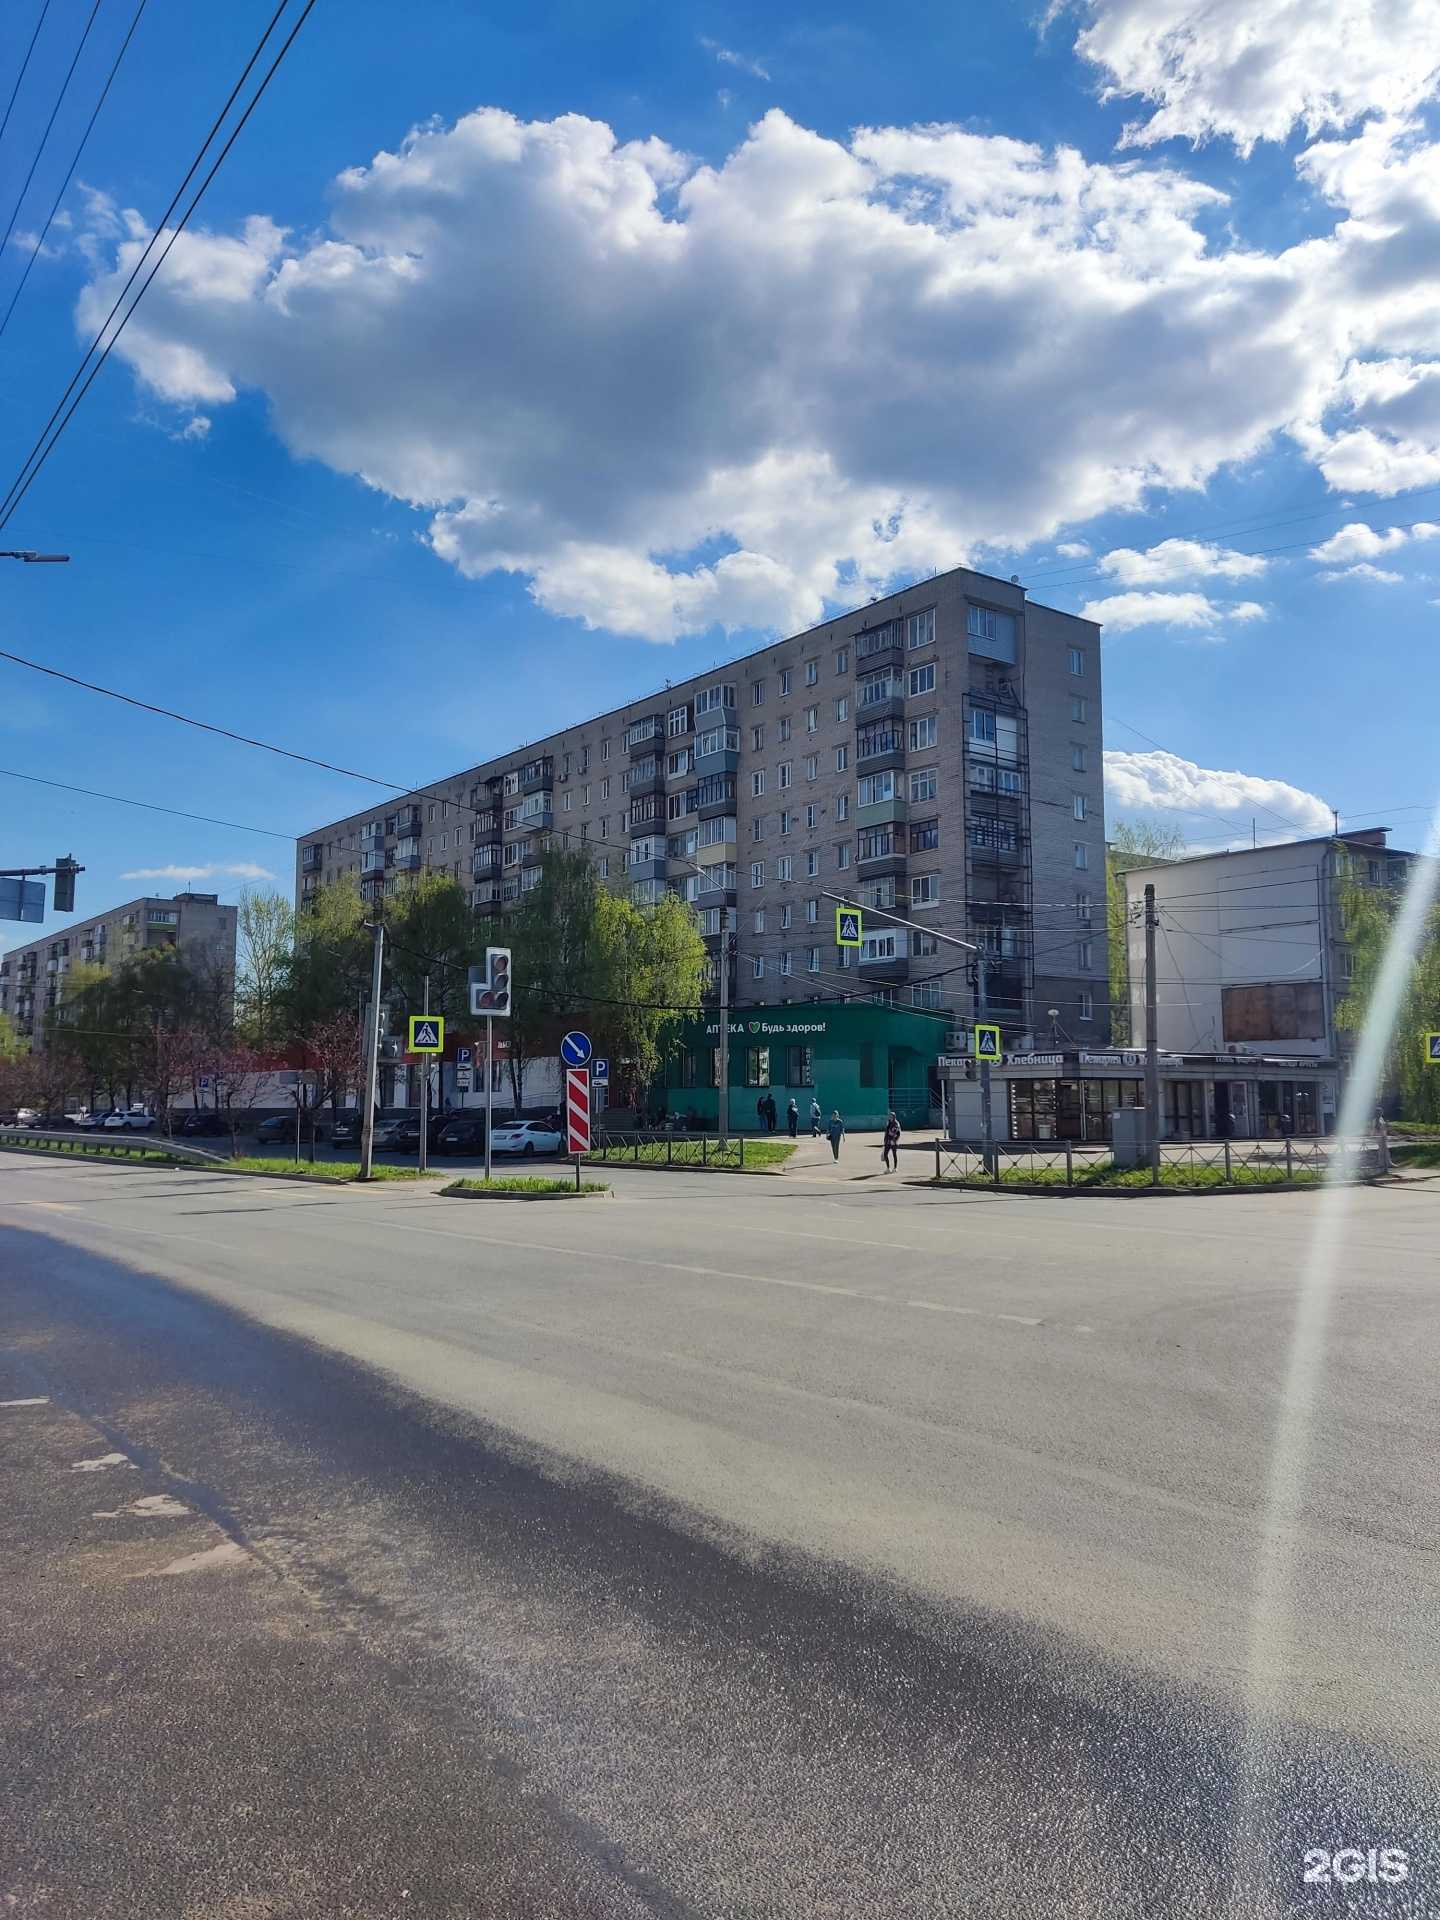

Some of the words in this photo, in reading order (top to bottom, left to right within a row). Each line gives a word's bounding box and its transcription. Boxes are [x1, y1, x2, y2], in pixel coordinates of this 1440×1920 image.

[706, 1023, 744, 1034] АПЕКА
[762, 1022, 784, 1034] Будь
[786, 1021, 826, 1034] здоров!
[938, 1056, 981, 1069] Пекаря
[1007, 1052, 1064, 1066] Хлебница
